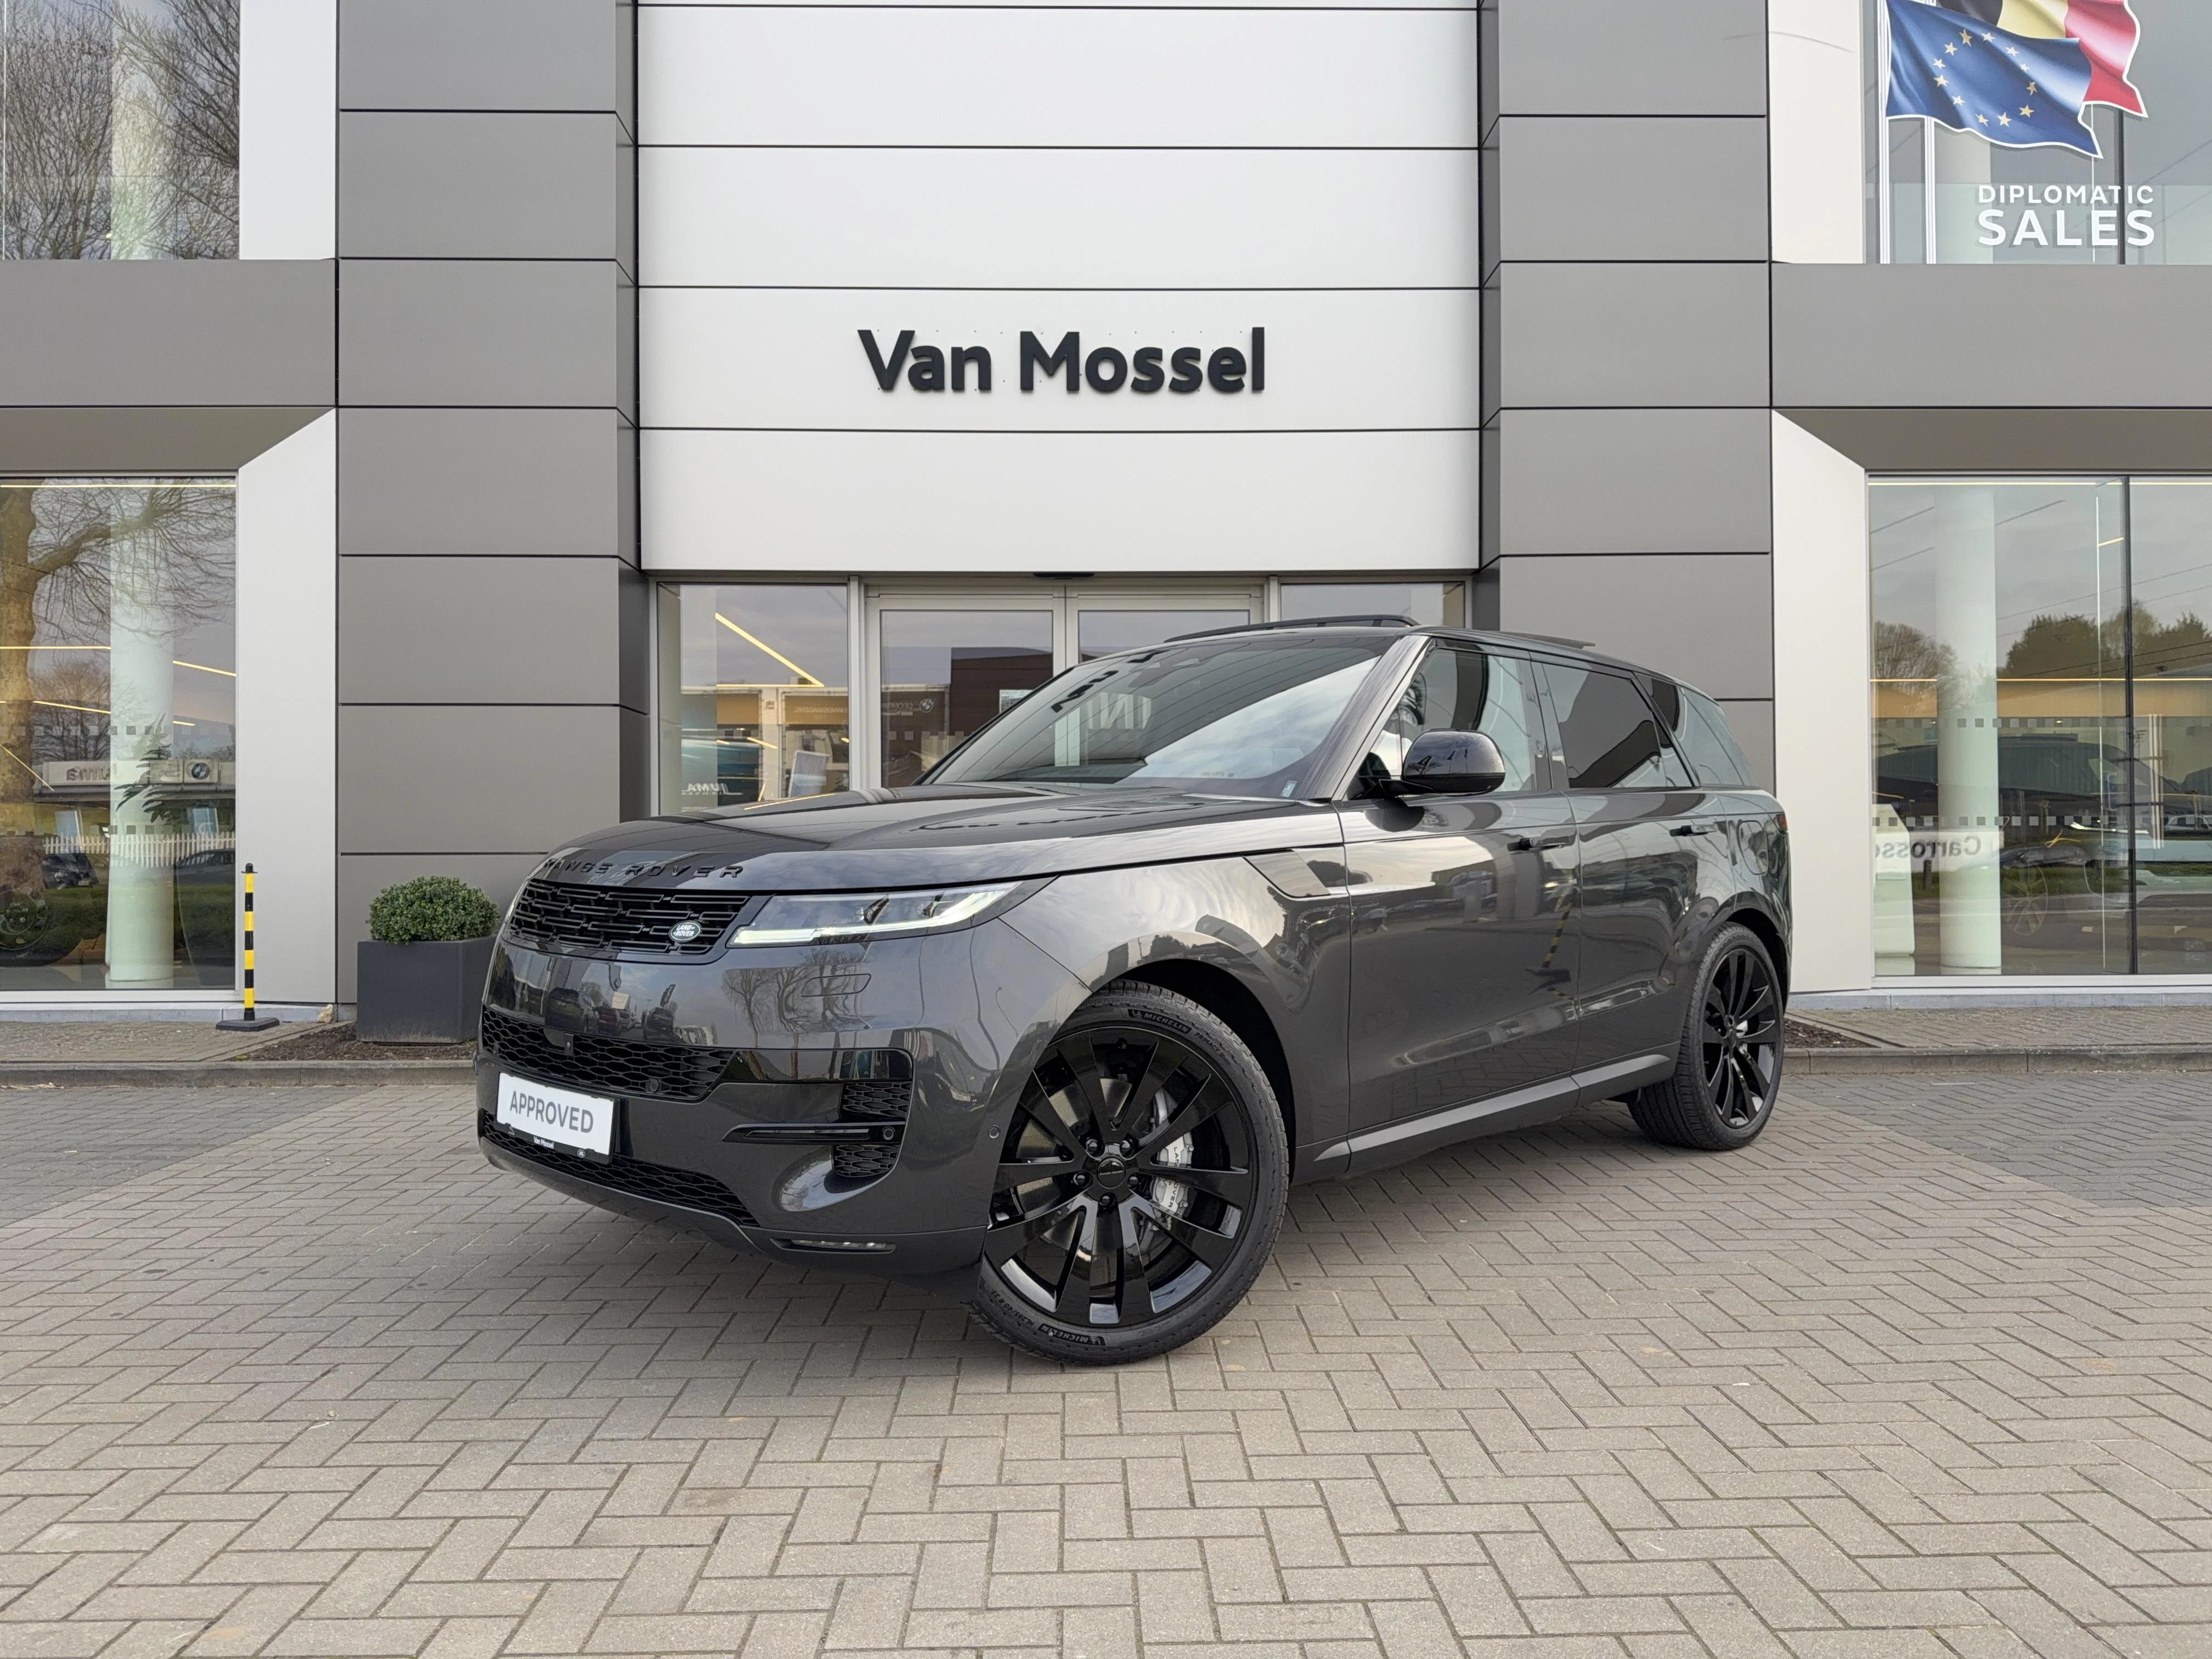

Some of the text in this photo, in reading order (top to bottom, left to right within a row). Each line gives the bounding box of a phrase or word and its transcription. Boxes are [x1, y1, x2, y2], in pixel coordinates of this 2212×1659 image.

[1978, 185, 2154, 204] DIPLOMATIC
[1978, 209, 2155, 246] SALES
[857, 327, 1265, 393] Van Mossel
[543, 859, 743, 878] RANGE ROVER
[1144, 1013, 1190, 1034] MICHELIN
[1194, 1032, 1221, 1052] PRIMACY
[510, 1090, 594, 1133] APPROVED
[541, 1138, 554, 1149] Mossel
[1042, 1324, 1089, 1343] MICHELIN
